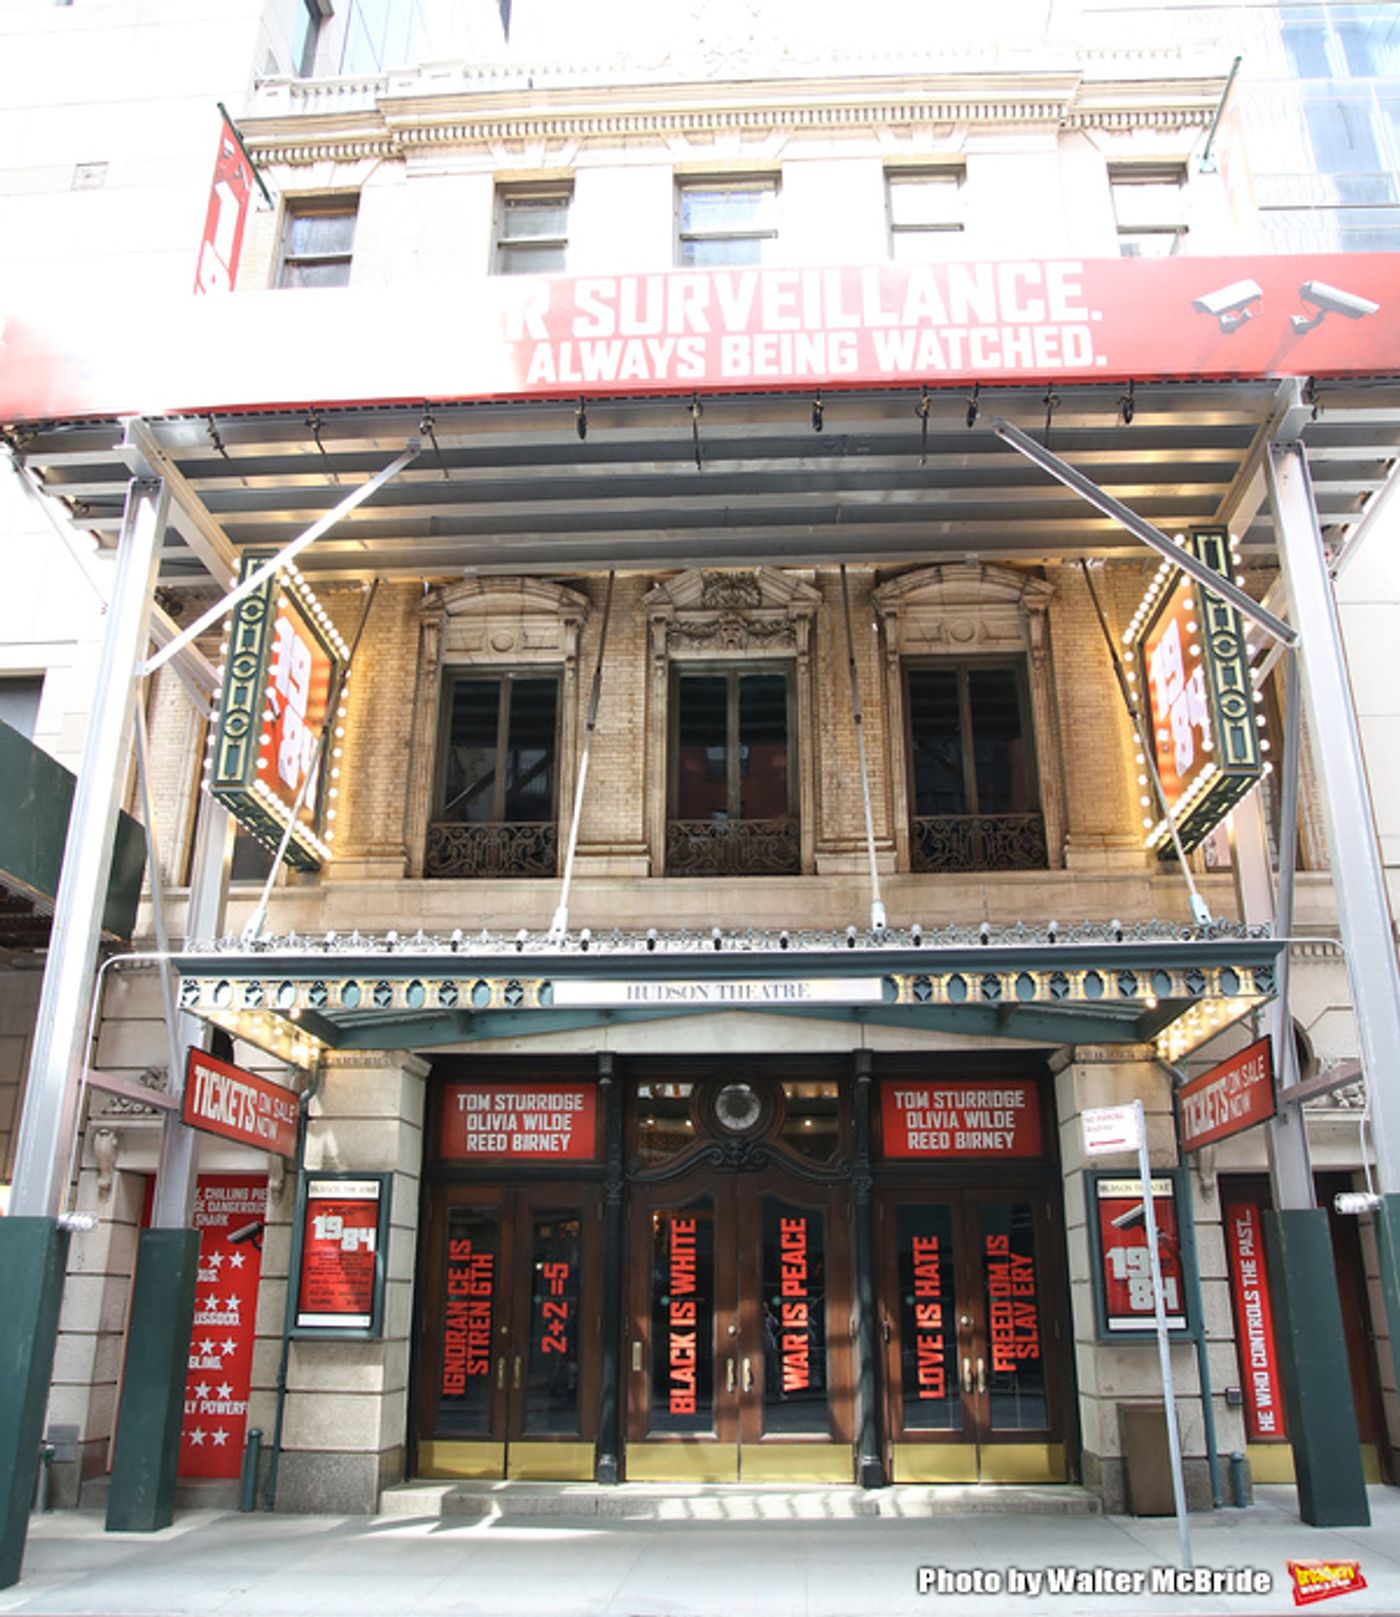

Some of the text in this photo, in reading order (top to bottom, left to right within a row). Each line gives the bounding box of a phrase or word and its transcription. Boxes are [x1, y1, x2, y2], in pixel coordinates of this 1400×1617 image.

[573, 261, 1102, 338] SURVEILLANCE.
[526, 323, 1107, 385] ALWAYS BEING WATCHED.
[627, 982, 810, 1000] HUDSON THEATRE
[1228, 1055, 1265, 1096] ON SALE
[193, 1064, 257, 1133] TICKETS
[258, 1092, 295, 1124] ON SALE
[457, 1093, 584, 1111] TOM STURRIDGE
[894, 1089, 1025, 1110] TOM STURRIDGE
[1183, 1076, 1229, 1140] TICKETS
[467, 1113, 573, 1131] OLIVIA WILDE
[906, 1110, 1016, 1129] OLIVIA WILDE
[467, 1133, 571, 1151] REED BIRNEY
[907, 1131, 1014, 1150] REED BIRNEY
[205, 1187, 248, 1201] CHILLING
[449, 1238, 472, 1261] IS
[986, 1234, 1009, 1256] IS
[1240, 1259, 1258, 1287] THE
[669, 1218, 696, 1414] BLACK IS WHITE
[780, 1217, 809, 1392] WAR IS PEACE
[912, 1235, 945, 1399] LOVE IS HATE
[1243, 1289, 1268, 1369] CONTROLS
[1252, 1371, 1272, 1408] WHO
[1256, 1410, 1275, 1433] HE
